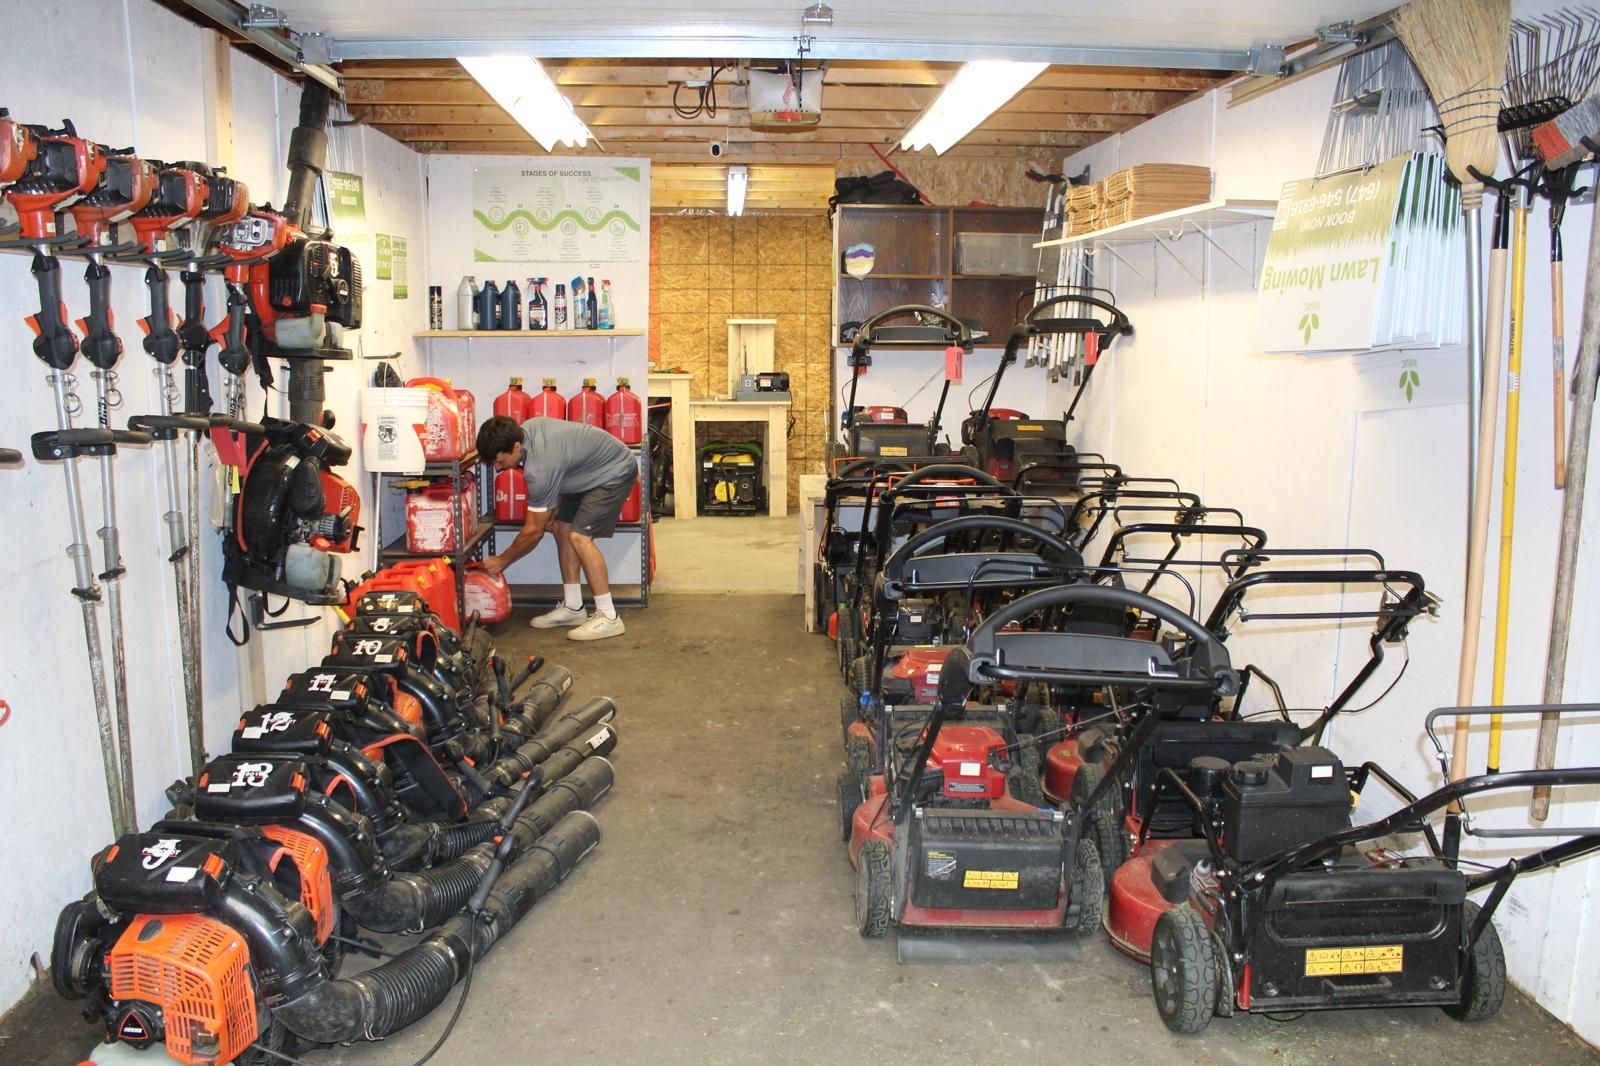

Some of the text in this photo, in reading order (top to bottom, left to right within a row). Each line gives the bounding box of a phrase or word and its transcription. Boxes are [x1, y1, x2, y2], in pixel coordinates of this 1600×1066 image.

[1325, 209, 1355, 228] BOOK
[1262, 256, 1381, 295] Lawn Mowing
[352, 639, 383, 656] 10
[308, 673, 336, 693] 11
[260, 711, 291, 733] 12
